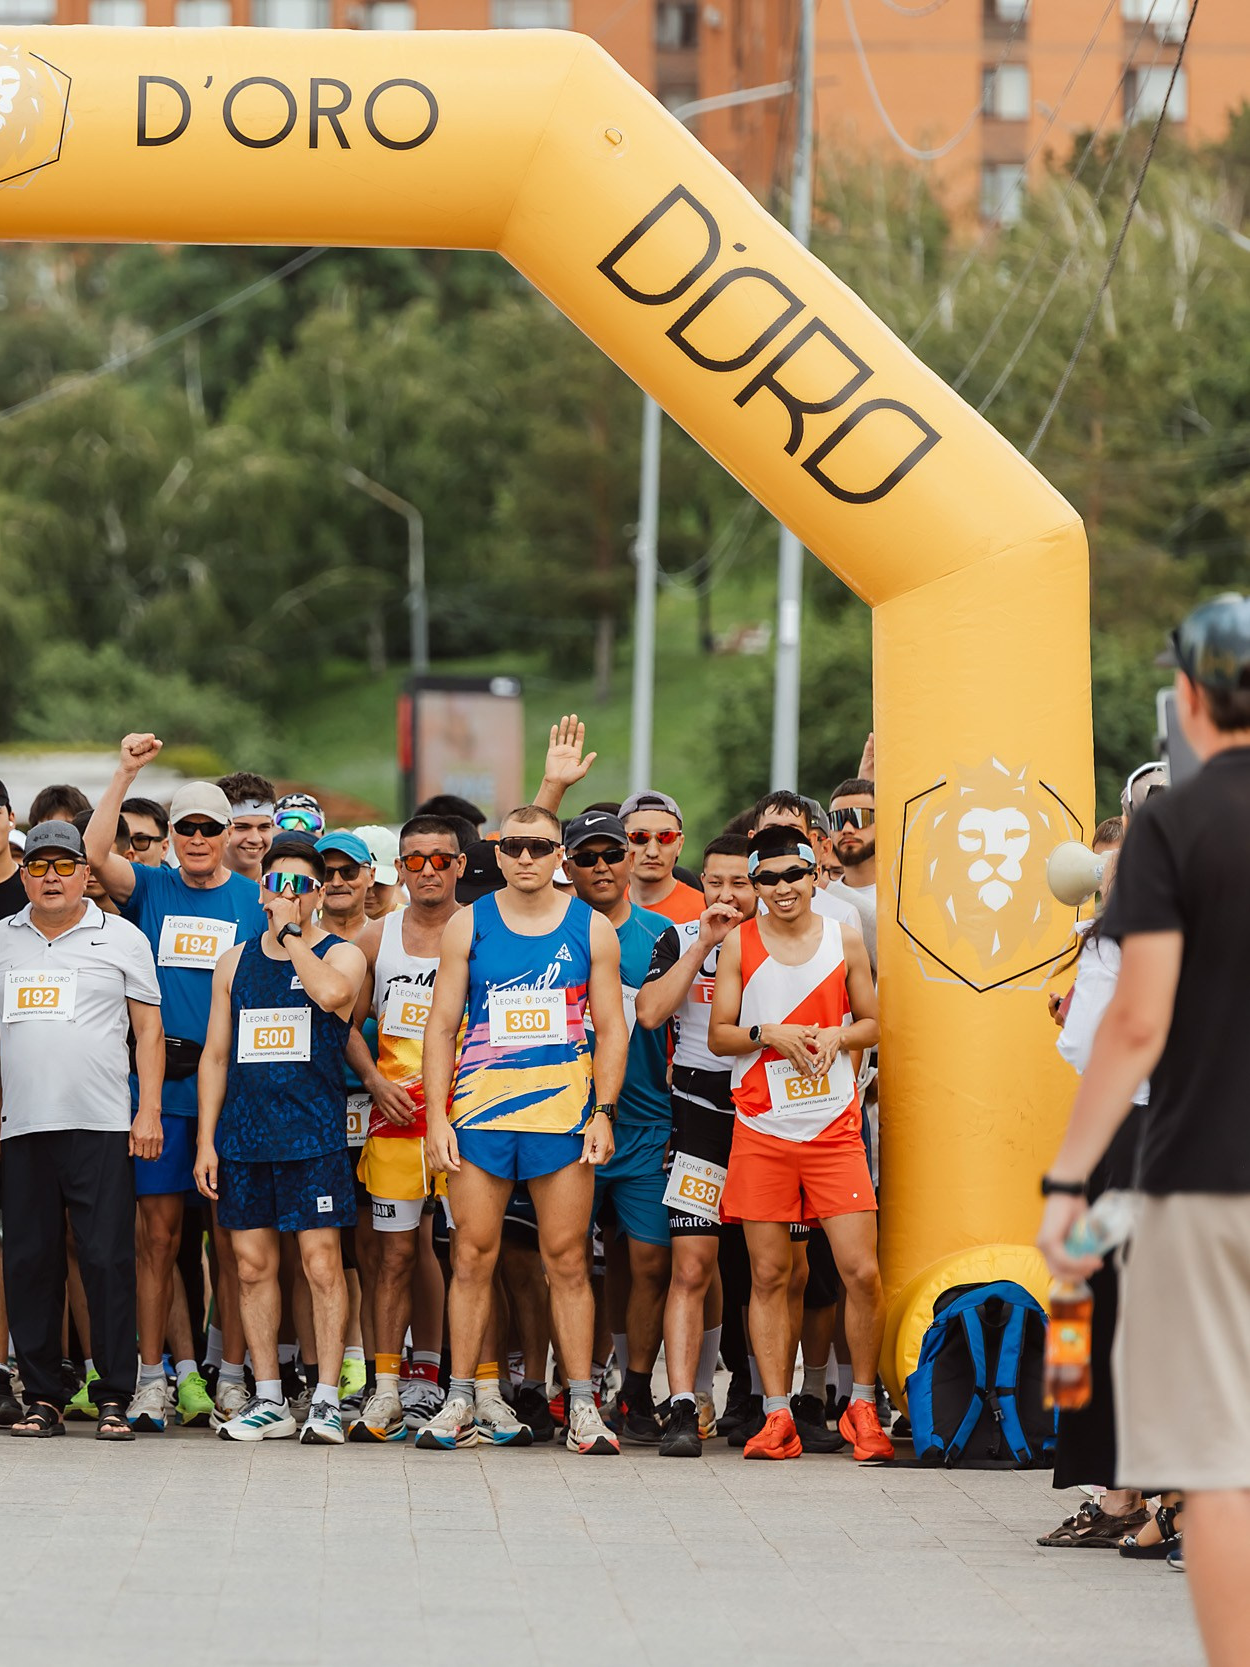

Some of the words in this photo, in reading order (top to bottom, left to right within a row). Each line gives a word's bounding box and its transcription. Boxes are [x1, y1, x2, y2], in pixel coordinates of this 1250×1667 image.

[136, 73, 440, 151] D'ORO
[169, 921, 194, 929] LEONE
[179, 936, 213, 954] 194
[22, 989, 56, 1006] 192
[396, 988, 422, 1000] LEONE
[495, 997, 522, 1006] LEONE
[245, 1015, 270, 1023] LEONE
[405, 1005, 429, 1025] 32
[510, 1012, 546, 1031] 360
[257, 1029, 291, 1047] 500
[772, 1065, 796, 1076] LEON
[790, 1075, 825, 1097] 337
[678, 1160, 703, 1174] LEONE
[683, 1178, 717, 1203] 338
[669, 1214, 712, 1228] mirates
